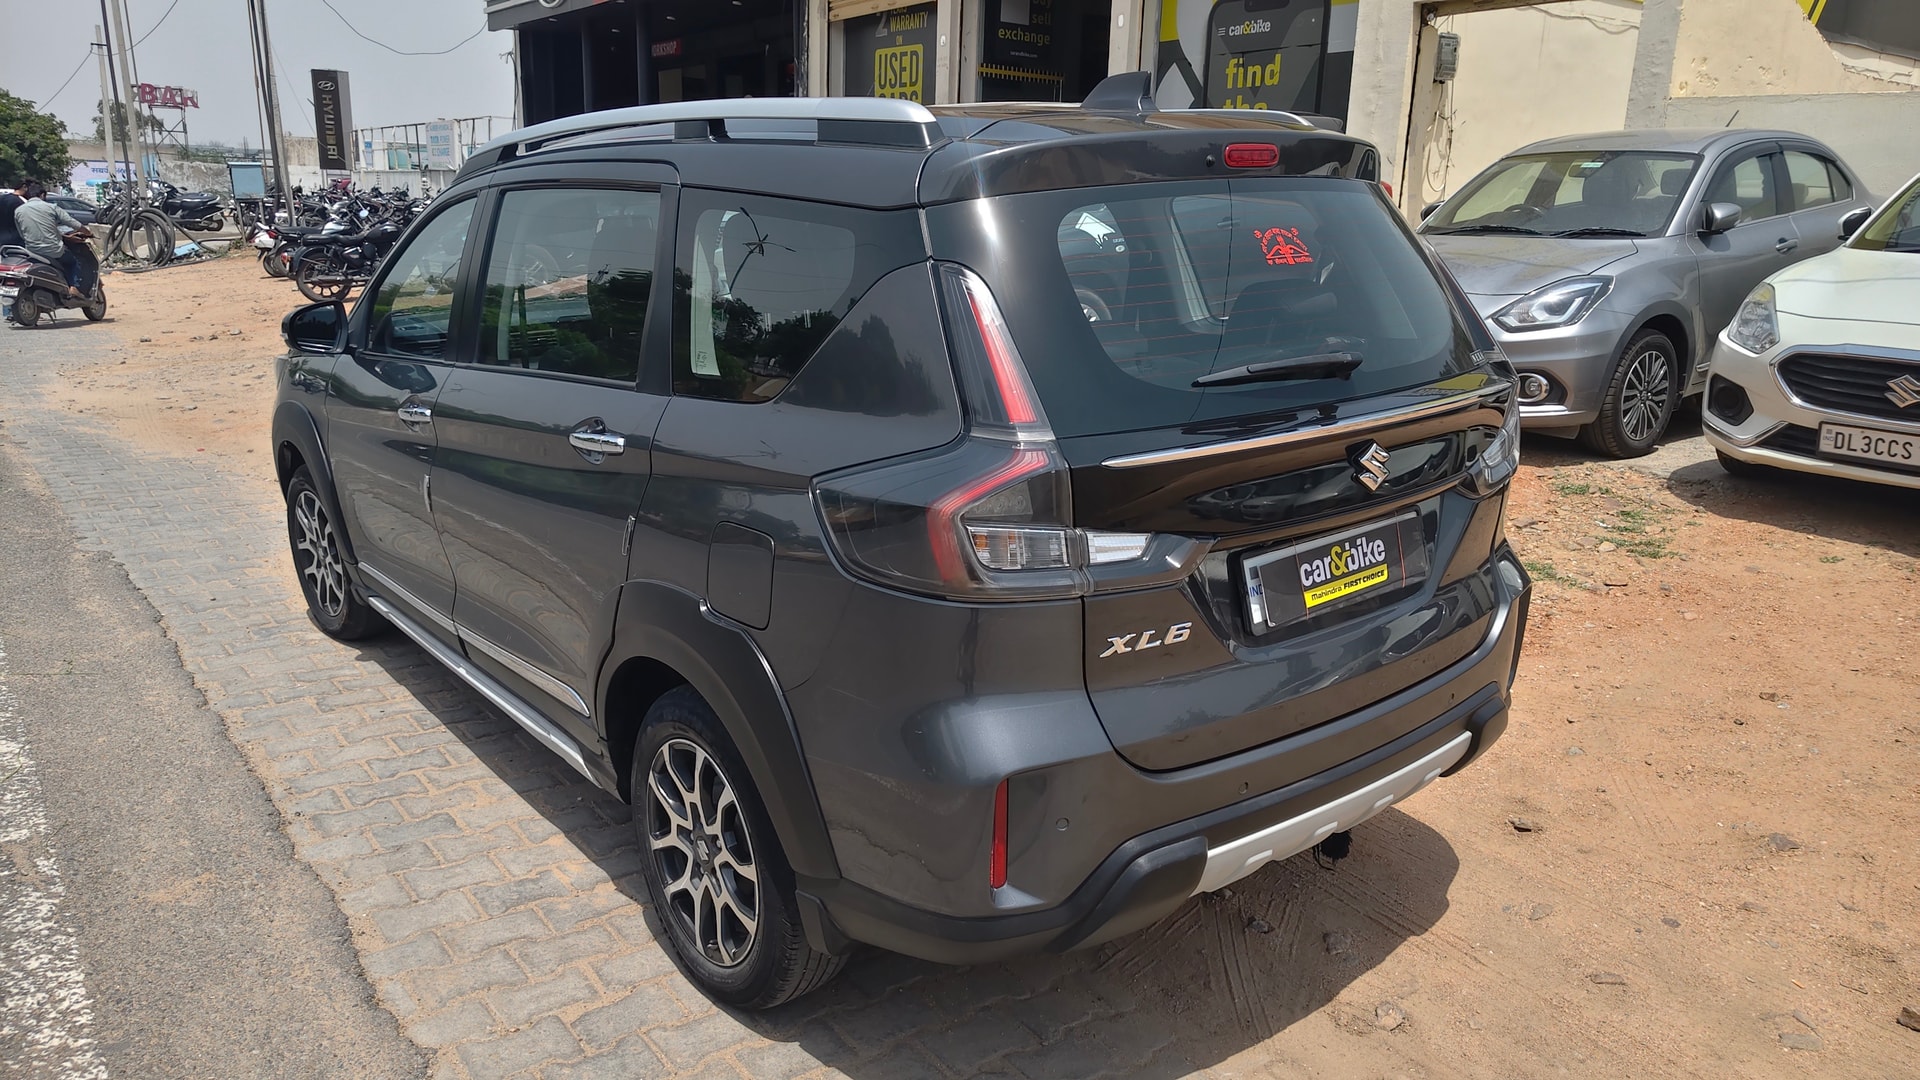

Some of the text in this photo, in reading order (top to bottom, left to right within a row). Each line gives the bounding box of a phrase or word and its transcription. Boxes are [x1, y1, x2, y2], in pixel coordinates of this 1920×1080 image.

[890, 11, 928, 32] WARRANTY
[1031, 11, 1051, 25] sell
[1228, 19, 1271, 36] car&bike
[998, 27, 1050, 46] exchange
[878, 50, 920, 90] USED
[1225, 53, 1282, 89] find
[1834, 431, 1913, 459] DL3CCS
[1300, 536, 1386, 587] car&bike
[1311, 569, 1385, 601] Mahindra FIRST CHOICE
[1099, 622, 1193, 658] XL6
